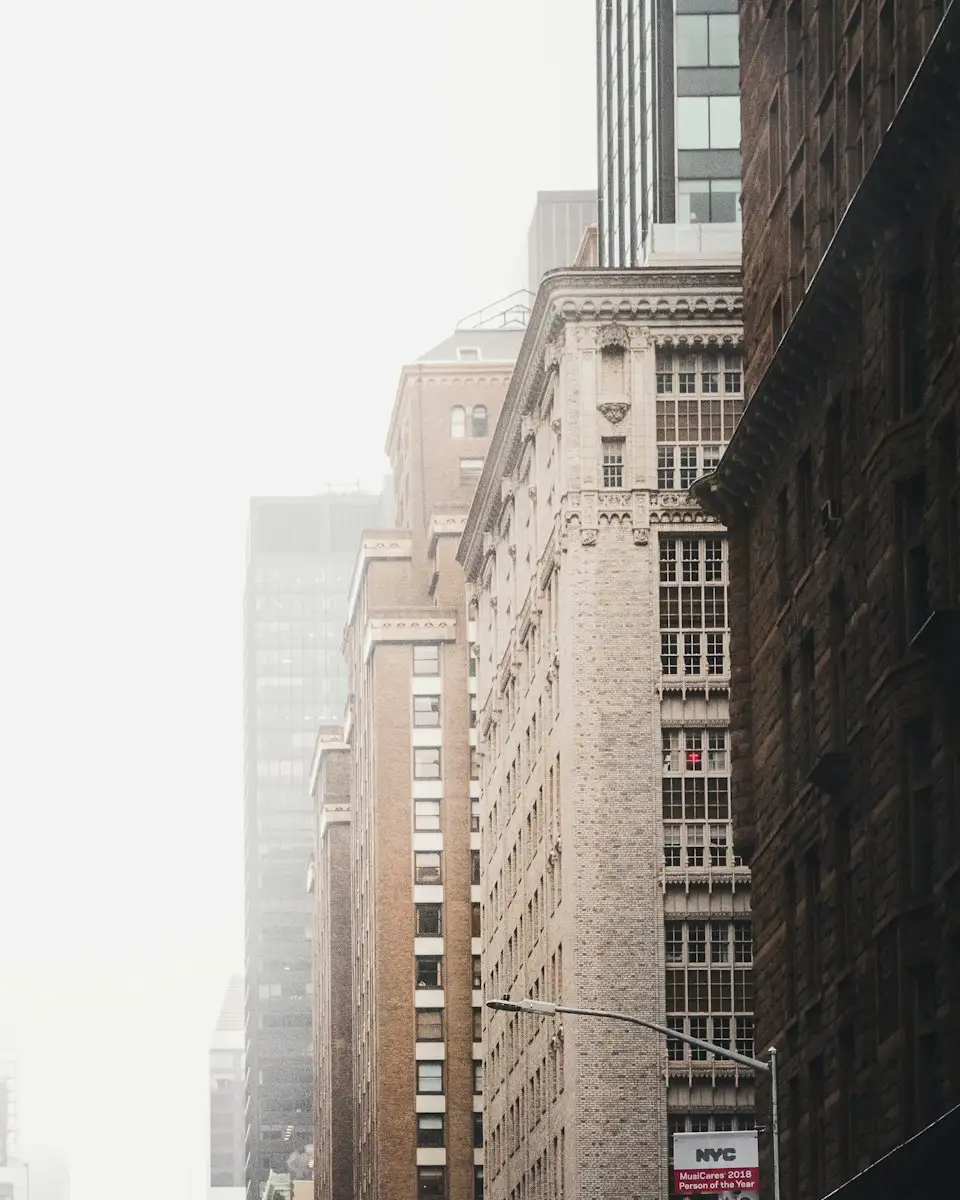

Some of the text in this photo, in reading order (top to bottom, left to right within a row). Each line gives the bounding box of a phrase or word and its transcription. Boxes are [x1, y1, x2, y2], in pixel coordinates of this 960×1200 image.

[696, 1148, 736, 1162] NYC
[728, 1170, 752, 1179] 2018
[679, 1180, 755, 1190] Person of the Year
